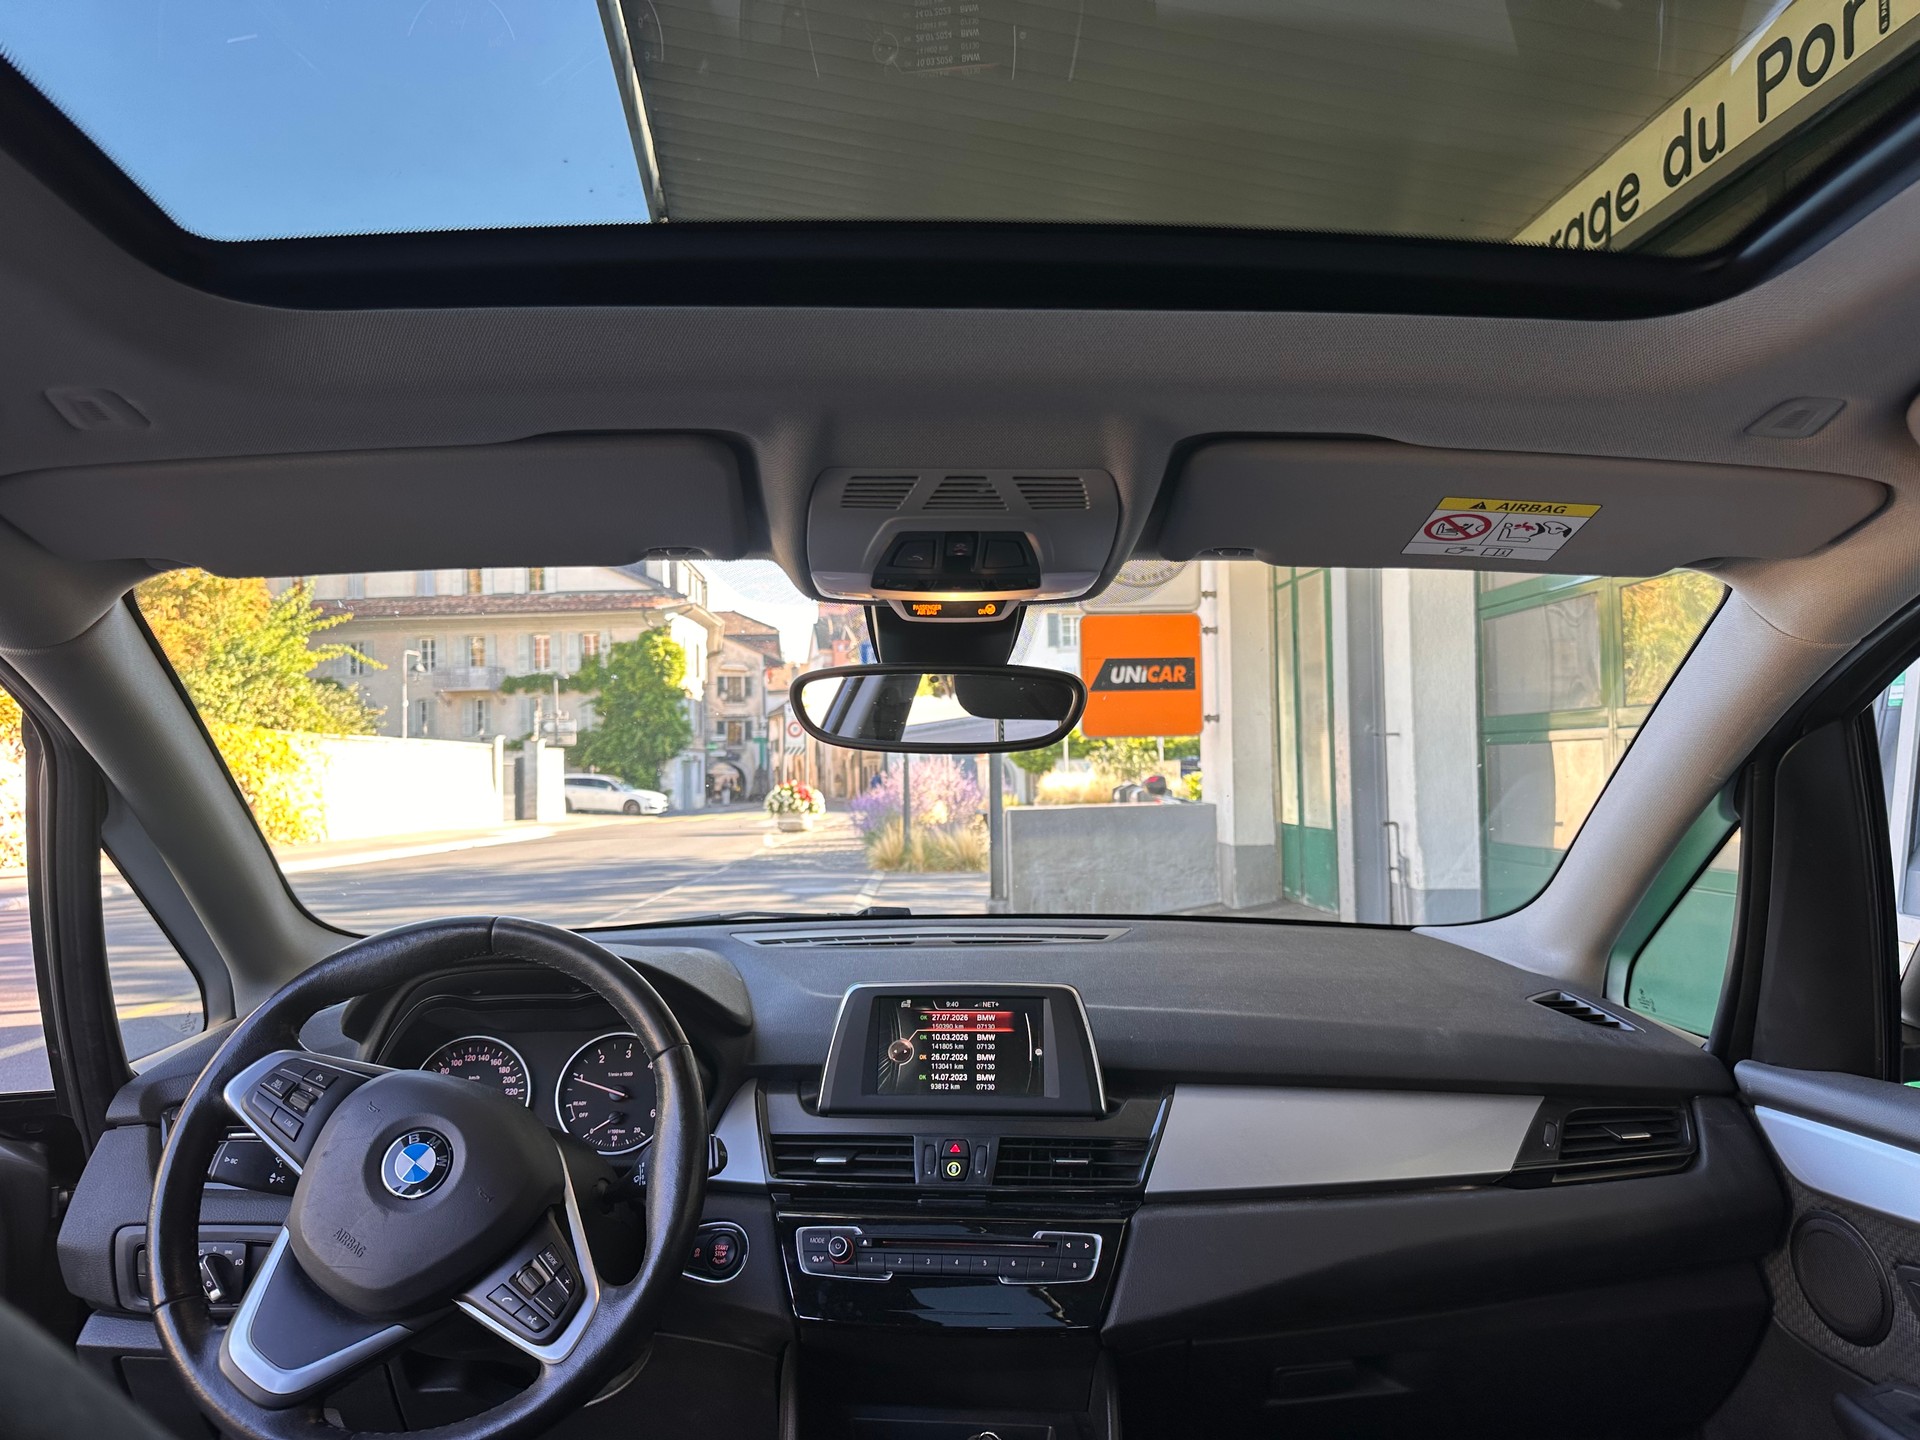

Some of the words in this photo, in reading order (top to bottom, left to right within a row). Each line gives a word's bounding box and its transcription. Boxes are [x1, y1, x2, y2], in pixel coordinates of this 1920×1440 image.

[1663, 102, 1726, 188] du
[1496, 502, 1568, 514] AIRBAG
[599, 1055, 605, 1063] 2
[625, 1050, 632, 1058] 3
[650, 1109, 656, 1118] 6
[408, 1133, 448, 1167] BMW
[332, 1228, 366, 1258] AIRBAG
